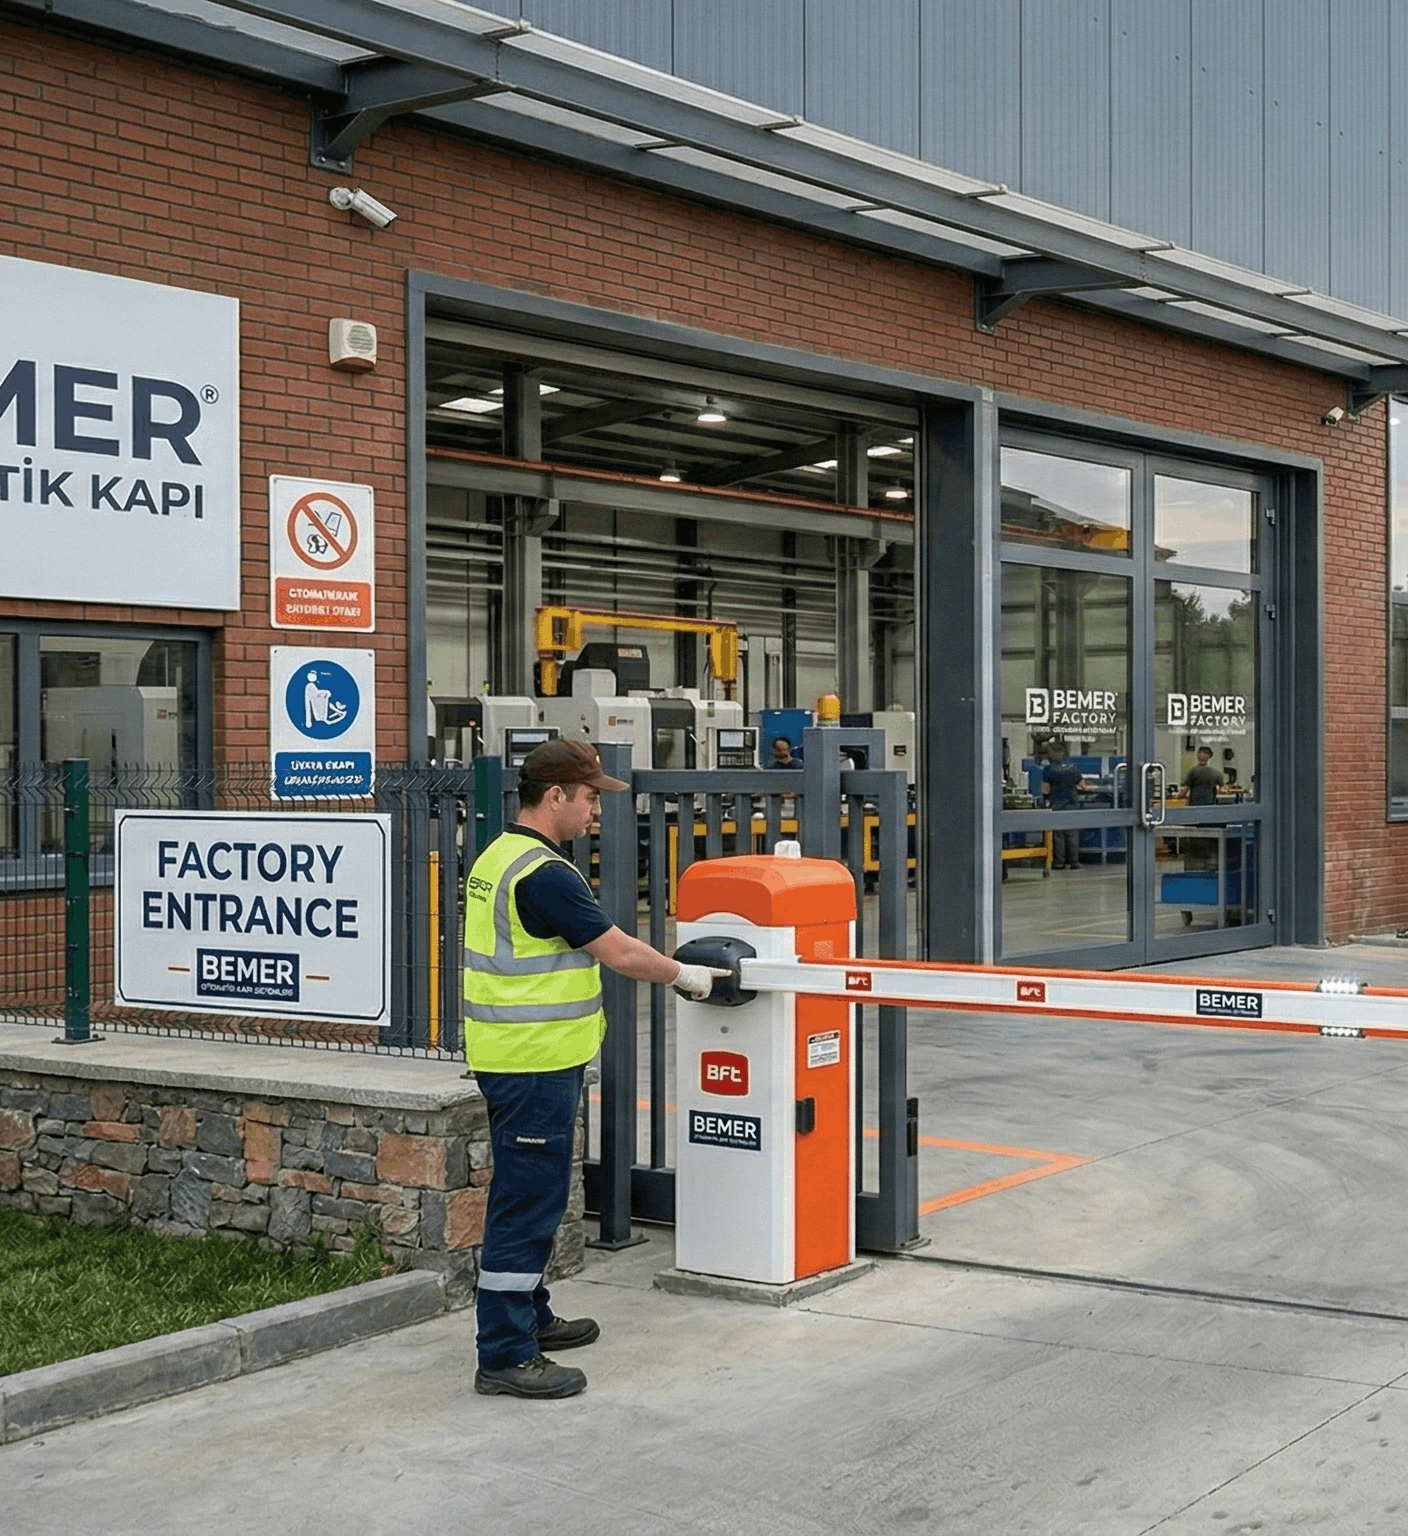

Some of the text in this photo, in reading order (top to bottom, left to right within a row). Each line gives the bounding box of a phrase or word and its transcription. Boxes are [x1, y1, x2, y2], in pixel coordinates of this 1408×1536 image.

[91, 474, 203, 519] KAPI
[1190, 694, 1246, 714] BEMER
[1053, 711, 1116, 724] FACTORY
[1190, 715, 1246, 727] FACTORY
[158, 840, 344, 884] FACTORY
[142, 890, 359, 939] ENTRANCE
[202, 954, 294, 986] BEMER
[1199, 993, 1259, 1010] BEMER
[694, 1115, 757, 1139] BEMER
